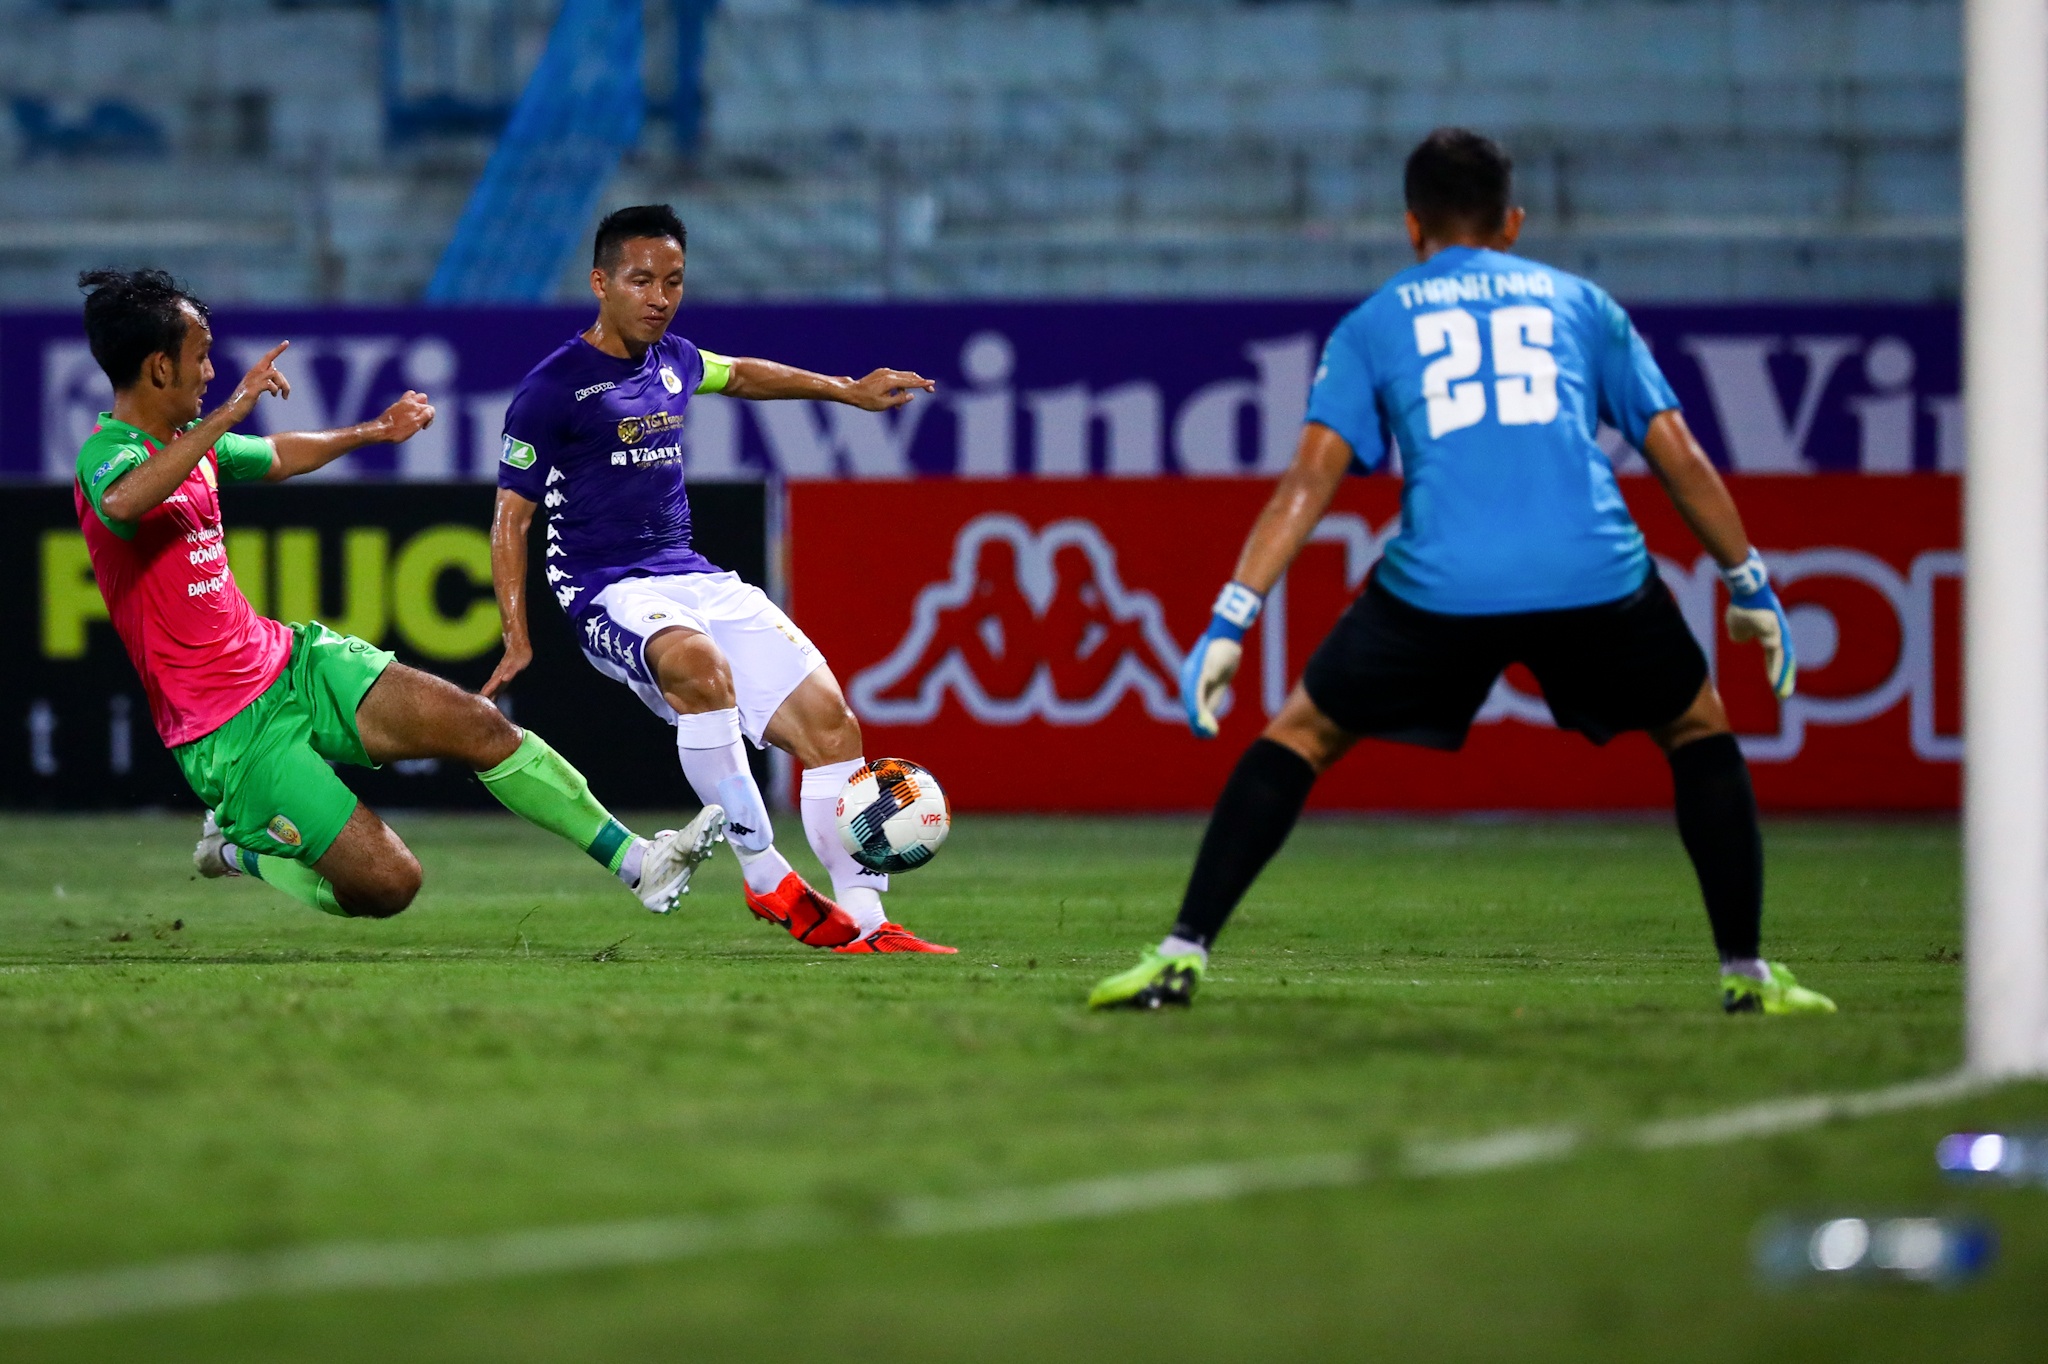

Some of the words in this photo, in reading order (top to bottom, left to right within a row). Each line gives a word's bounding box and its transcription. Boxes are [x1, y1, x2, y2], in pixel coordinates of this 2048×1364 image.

[225, 331, 1317, 478] Viwind
[575, 381, 617, 401] Kappa
[1413, 305, 1559, 441] 25
[1676, 332, 1965, 476] Vi
[643, 411, 668, 429] T&T
[920, 814, 942, 826] VPF
